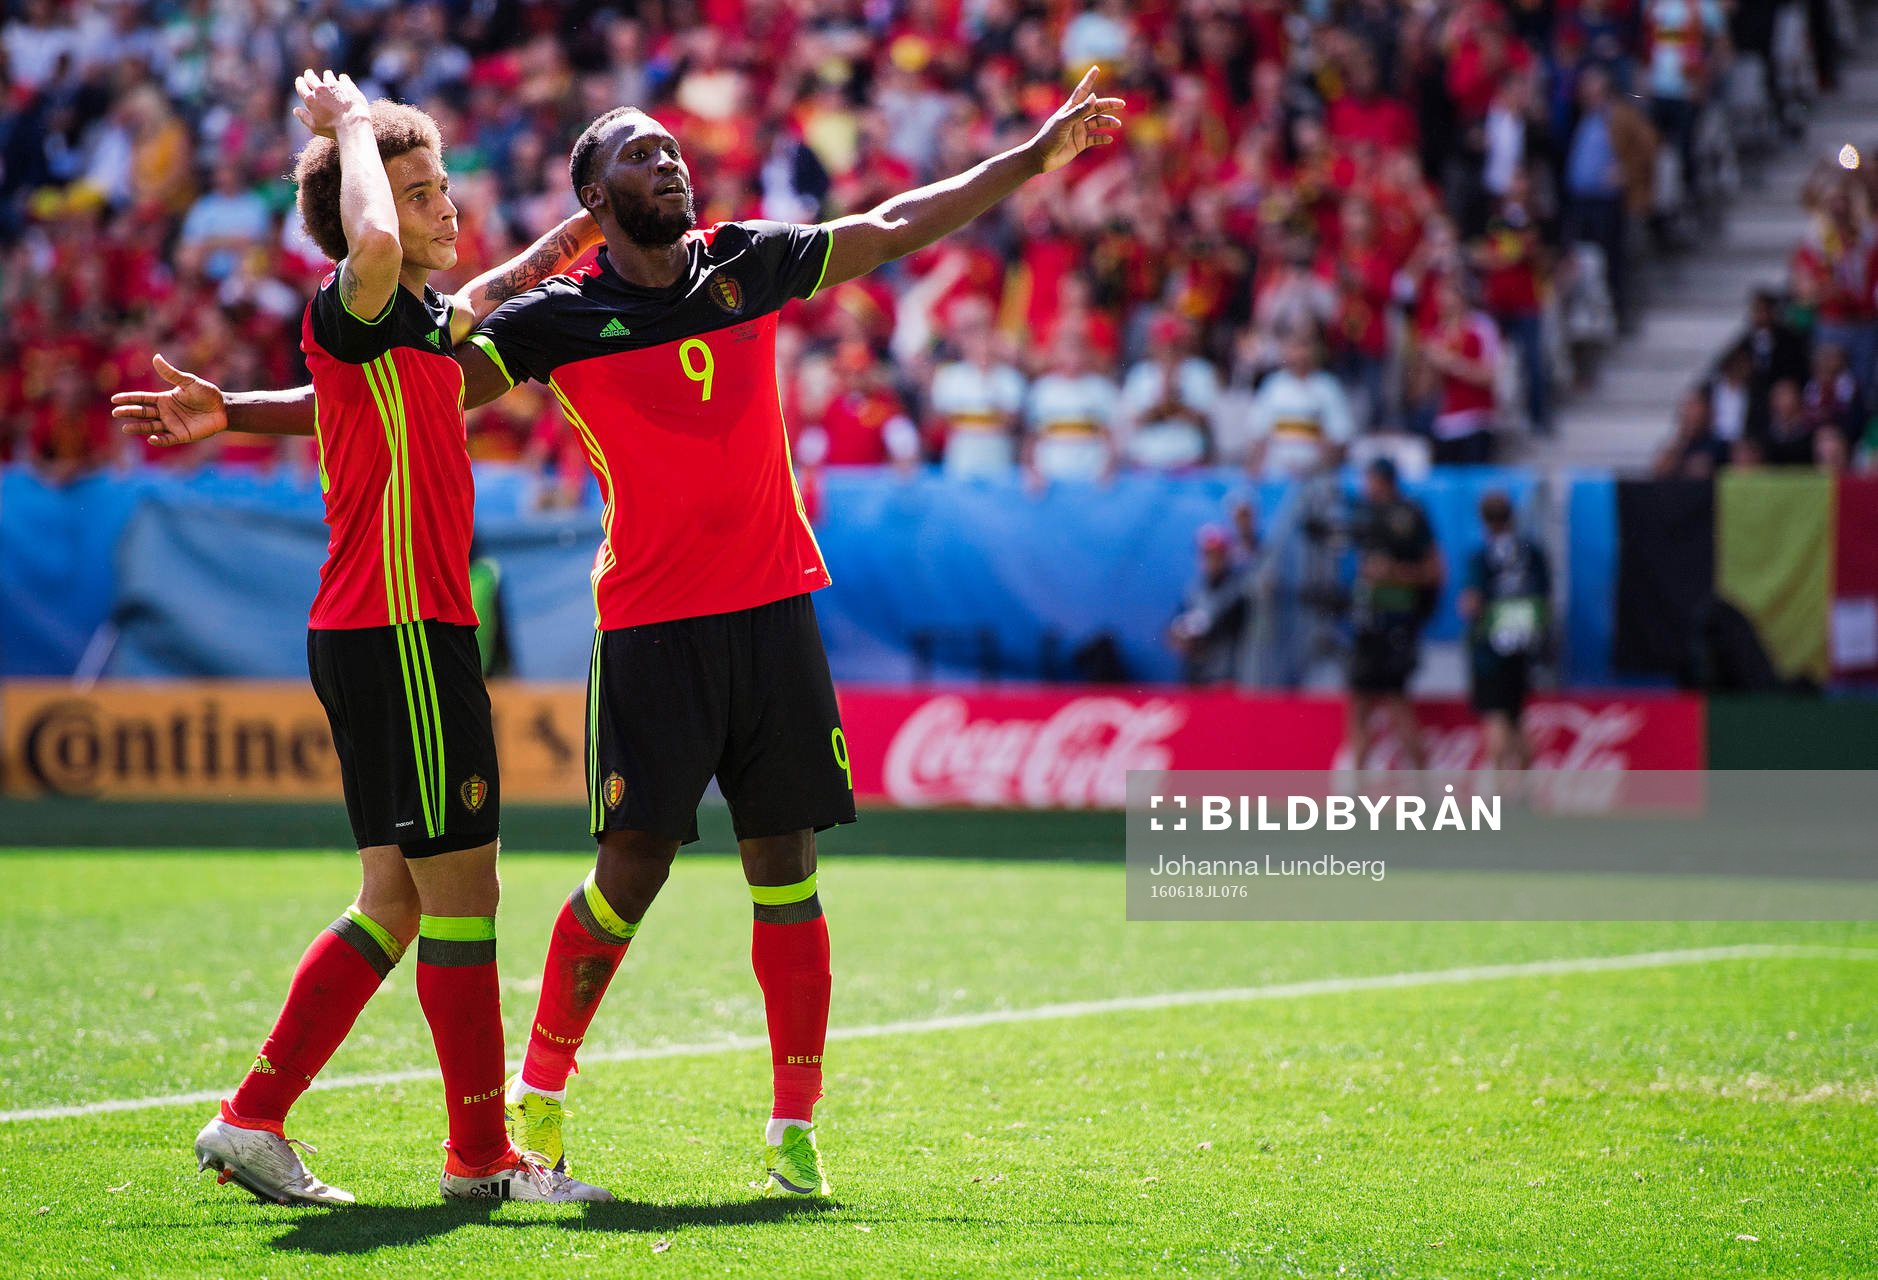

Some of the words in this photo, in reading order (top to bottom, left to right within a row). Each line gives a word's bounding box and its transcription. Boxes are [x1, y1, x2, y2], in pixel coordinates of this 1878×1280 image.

[600, 328, 631, 338] adidas
[679, 338, 715, 401] 9
[21, 698, 332, 795] Contine
[831, 727, 853, 790] 9
